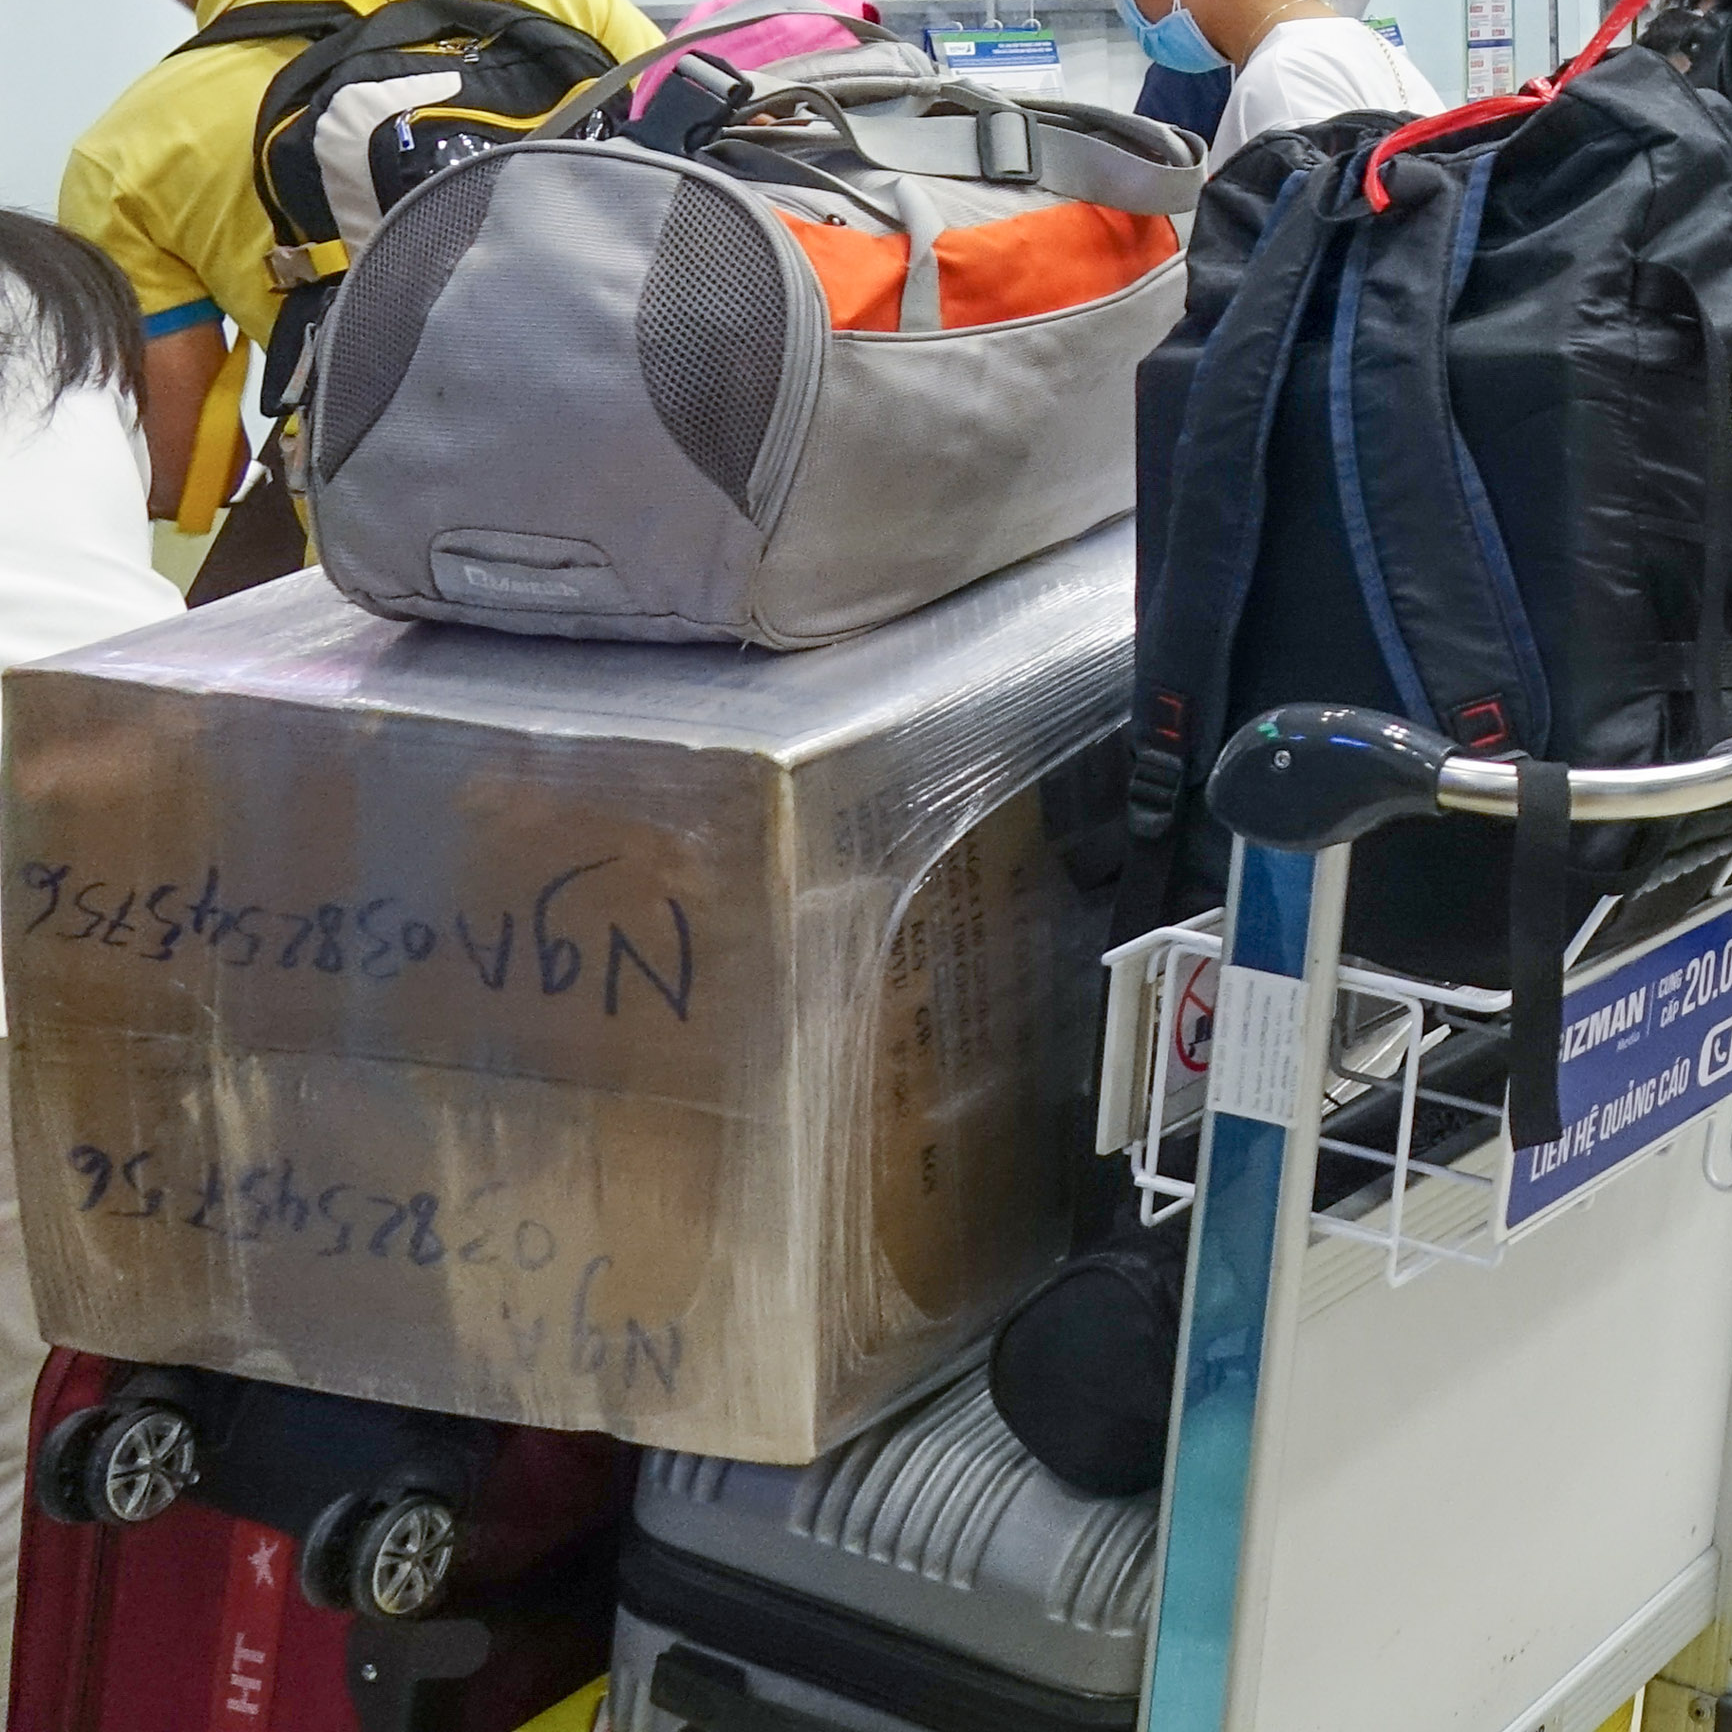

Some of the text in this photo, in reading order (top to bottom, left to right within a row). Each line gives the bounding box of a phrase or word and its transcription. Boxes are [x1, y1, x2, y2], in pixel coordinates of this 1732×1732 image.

[1658, 968, 1683, 1028] CUNG CẤP
[1573, 1104, 1600, 1156] HỆ
[1600, 1080, 1656, 1141] QUẢNG
[1657, 1057, 1690, 1108] CÁO
